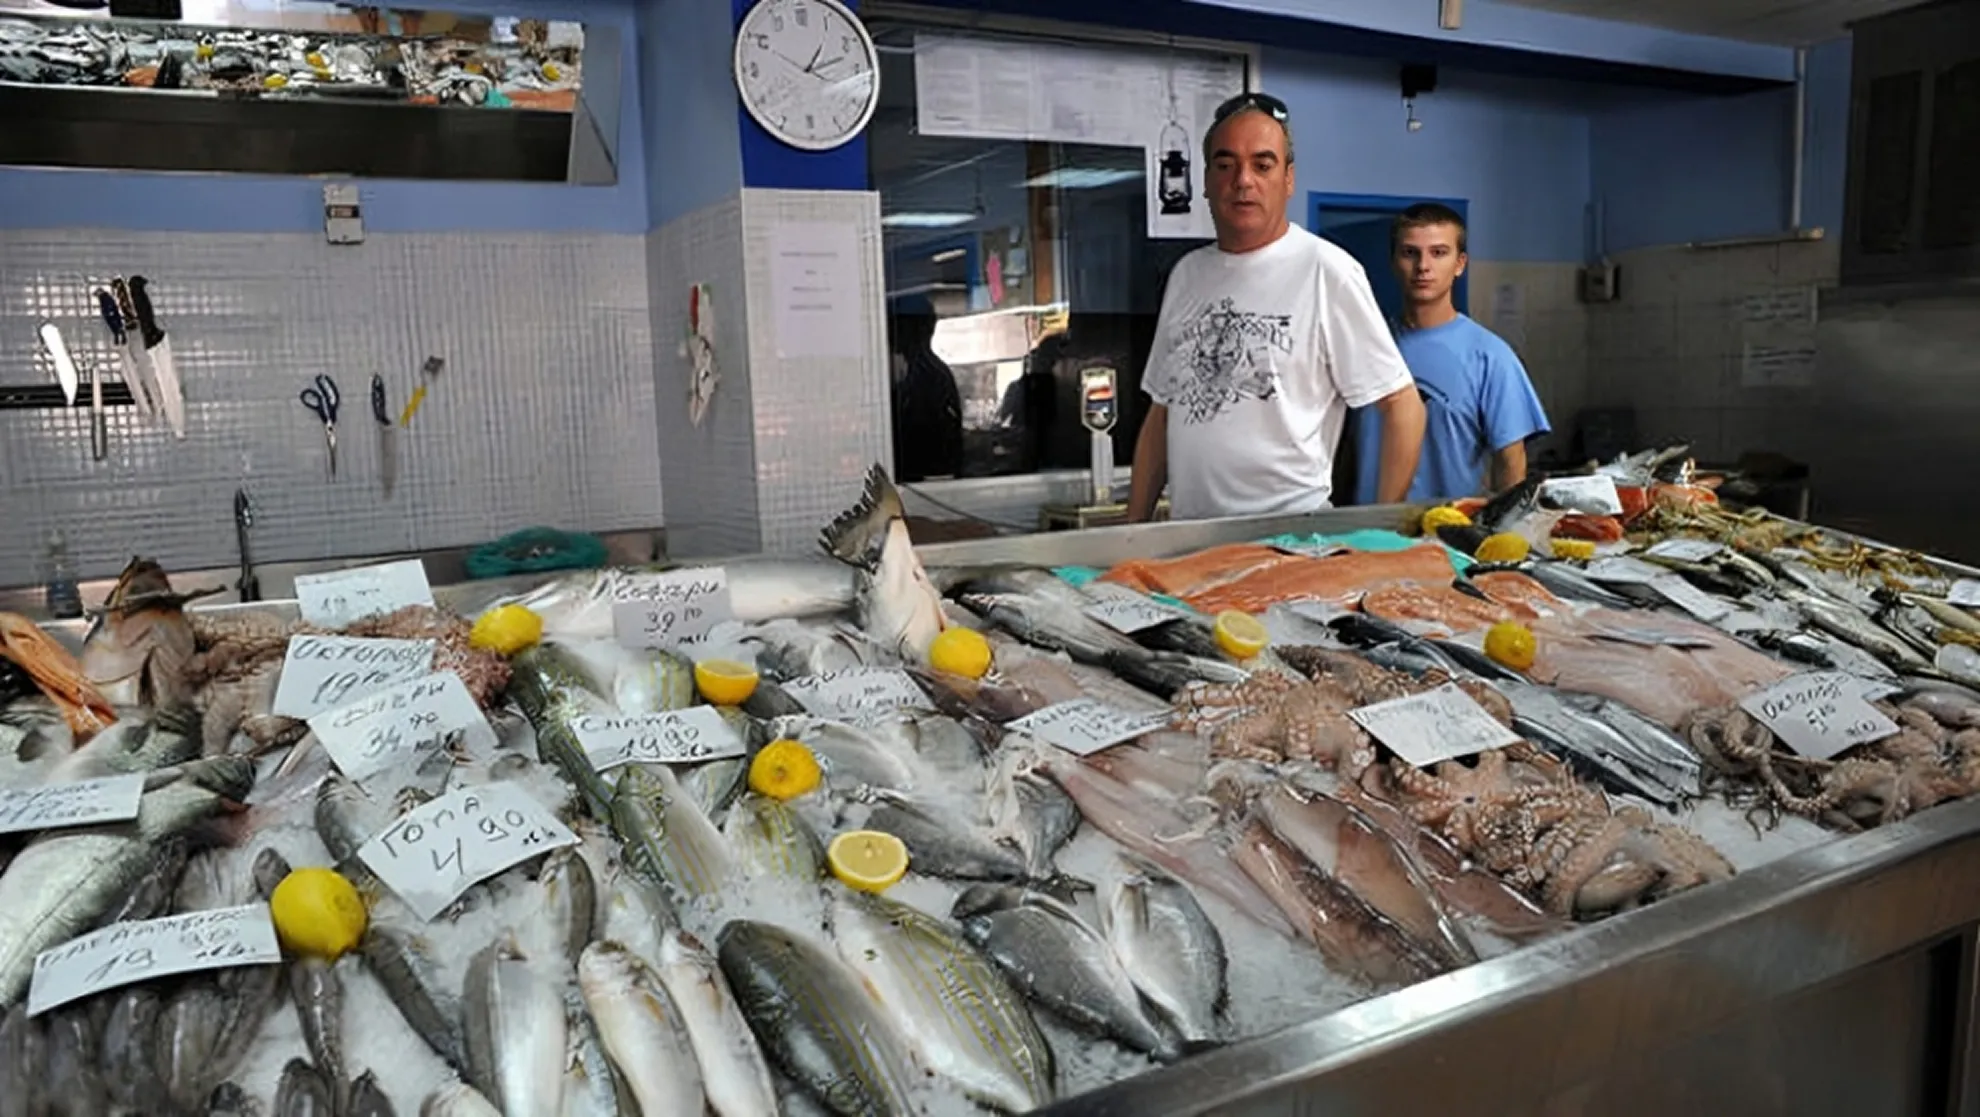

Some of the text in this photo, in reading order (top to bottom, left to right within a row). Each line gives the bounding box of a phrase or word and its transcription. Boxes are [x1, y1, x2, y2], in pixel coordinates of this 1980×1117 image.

[380, 796, 481, 859] ГОПА
[431, 836, 464, 876] 4
[478, 808, 525, 842] 90
